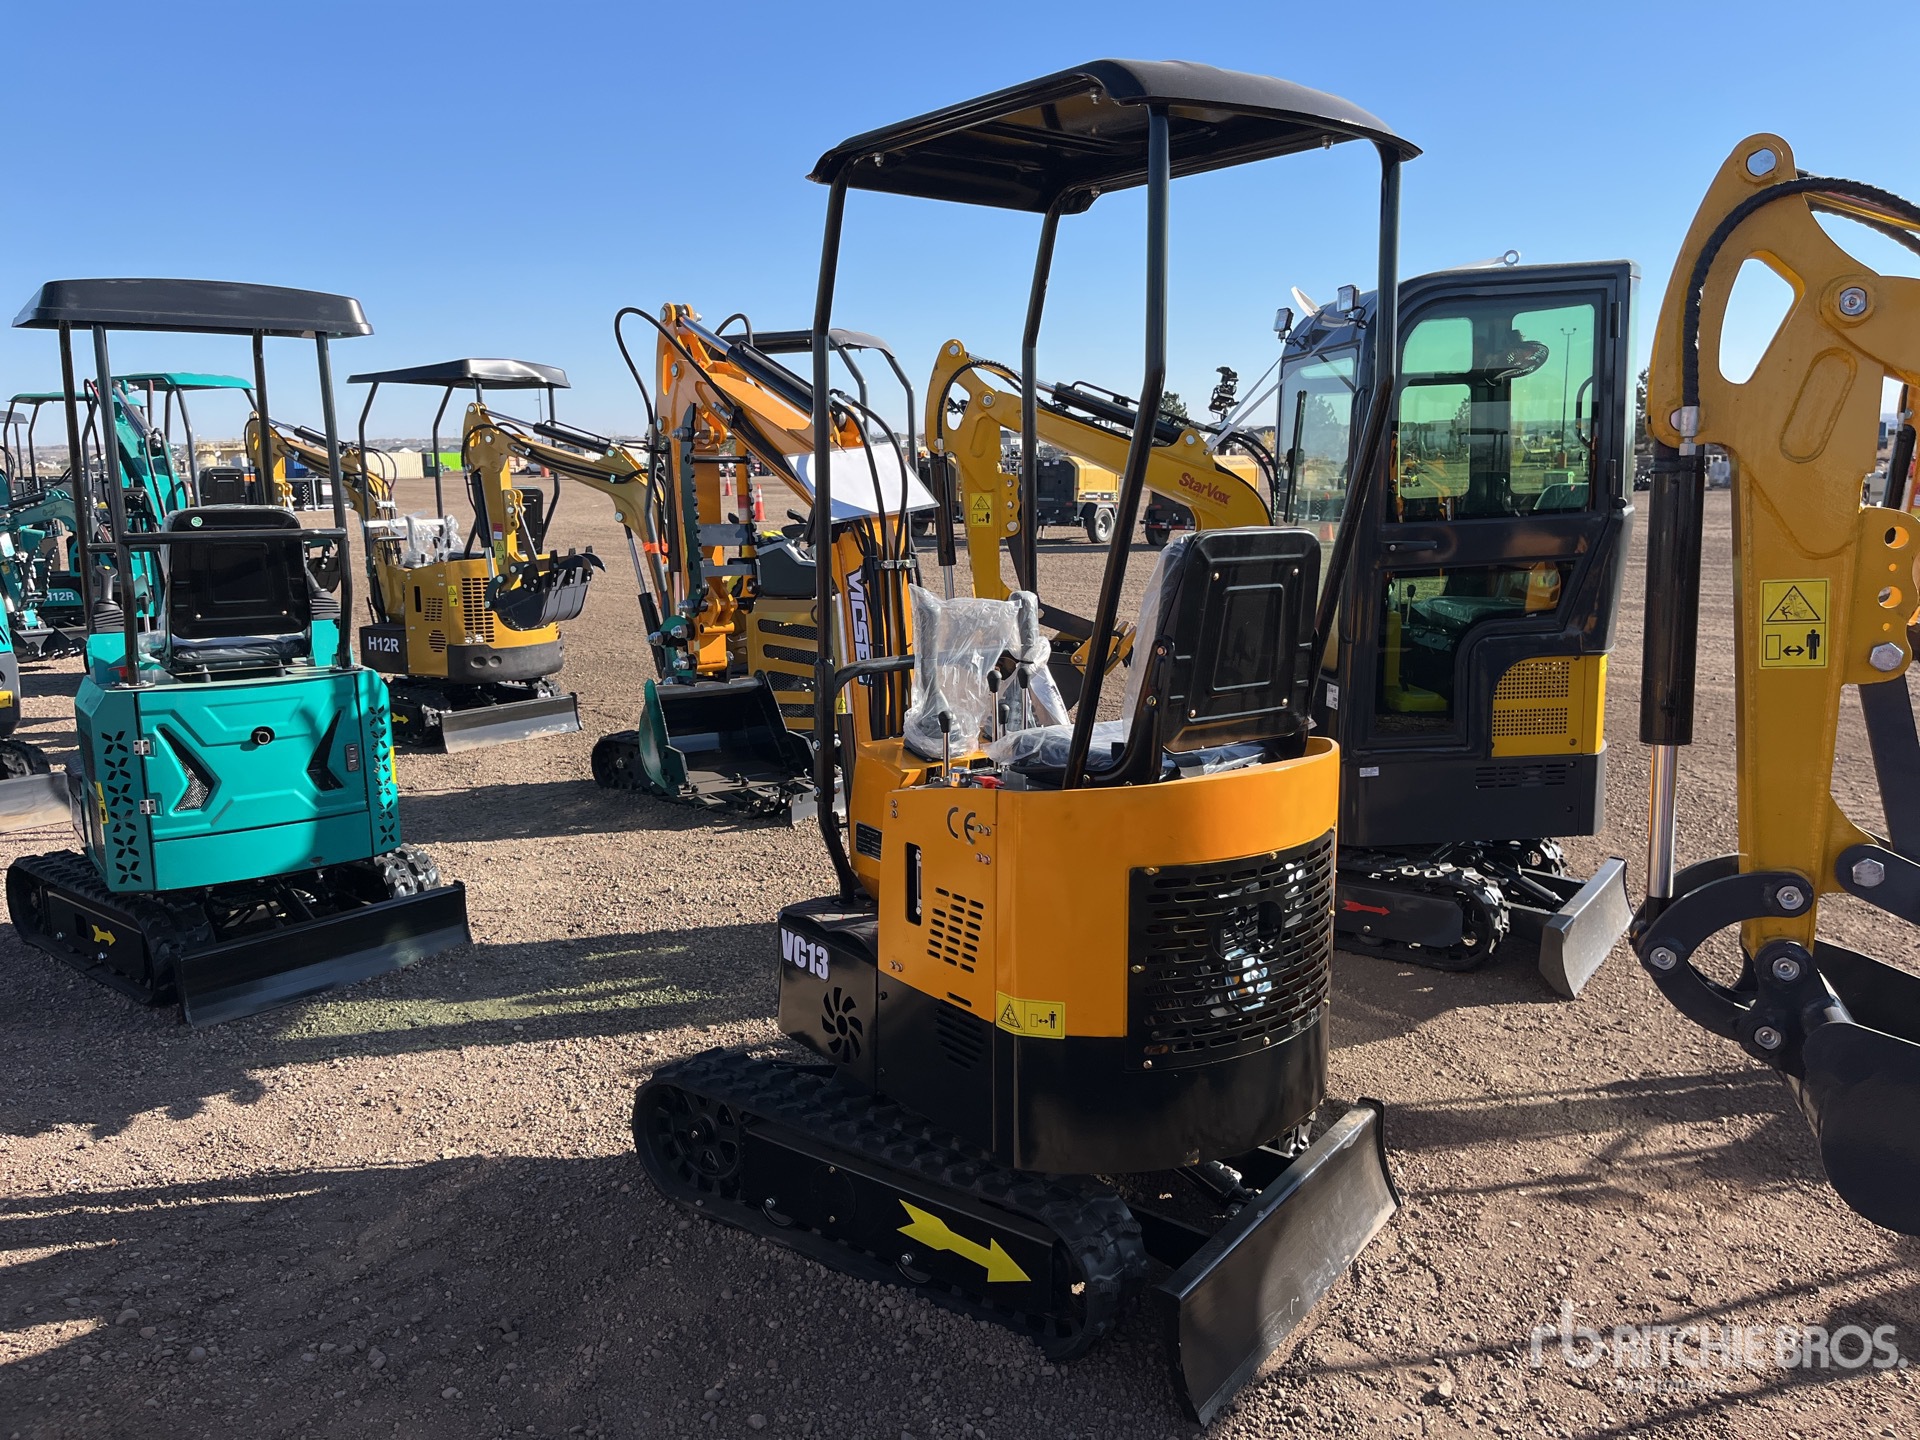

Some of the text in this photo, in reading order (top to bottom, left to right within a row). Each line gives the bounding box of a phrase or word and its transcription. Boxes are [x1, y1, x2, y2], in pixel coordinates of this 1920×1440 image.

[1178, 472, 1231, 505] StarVox
[367, 636, 400, 653] H12R
[946, 806, 976, 845] CE
[781, 927, 829, 980] VC13
